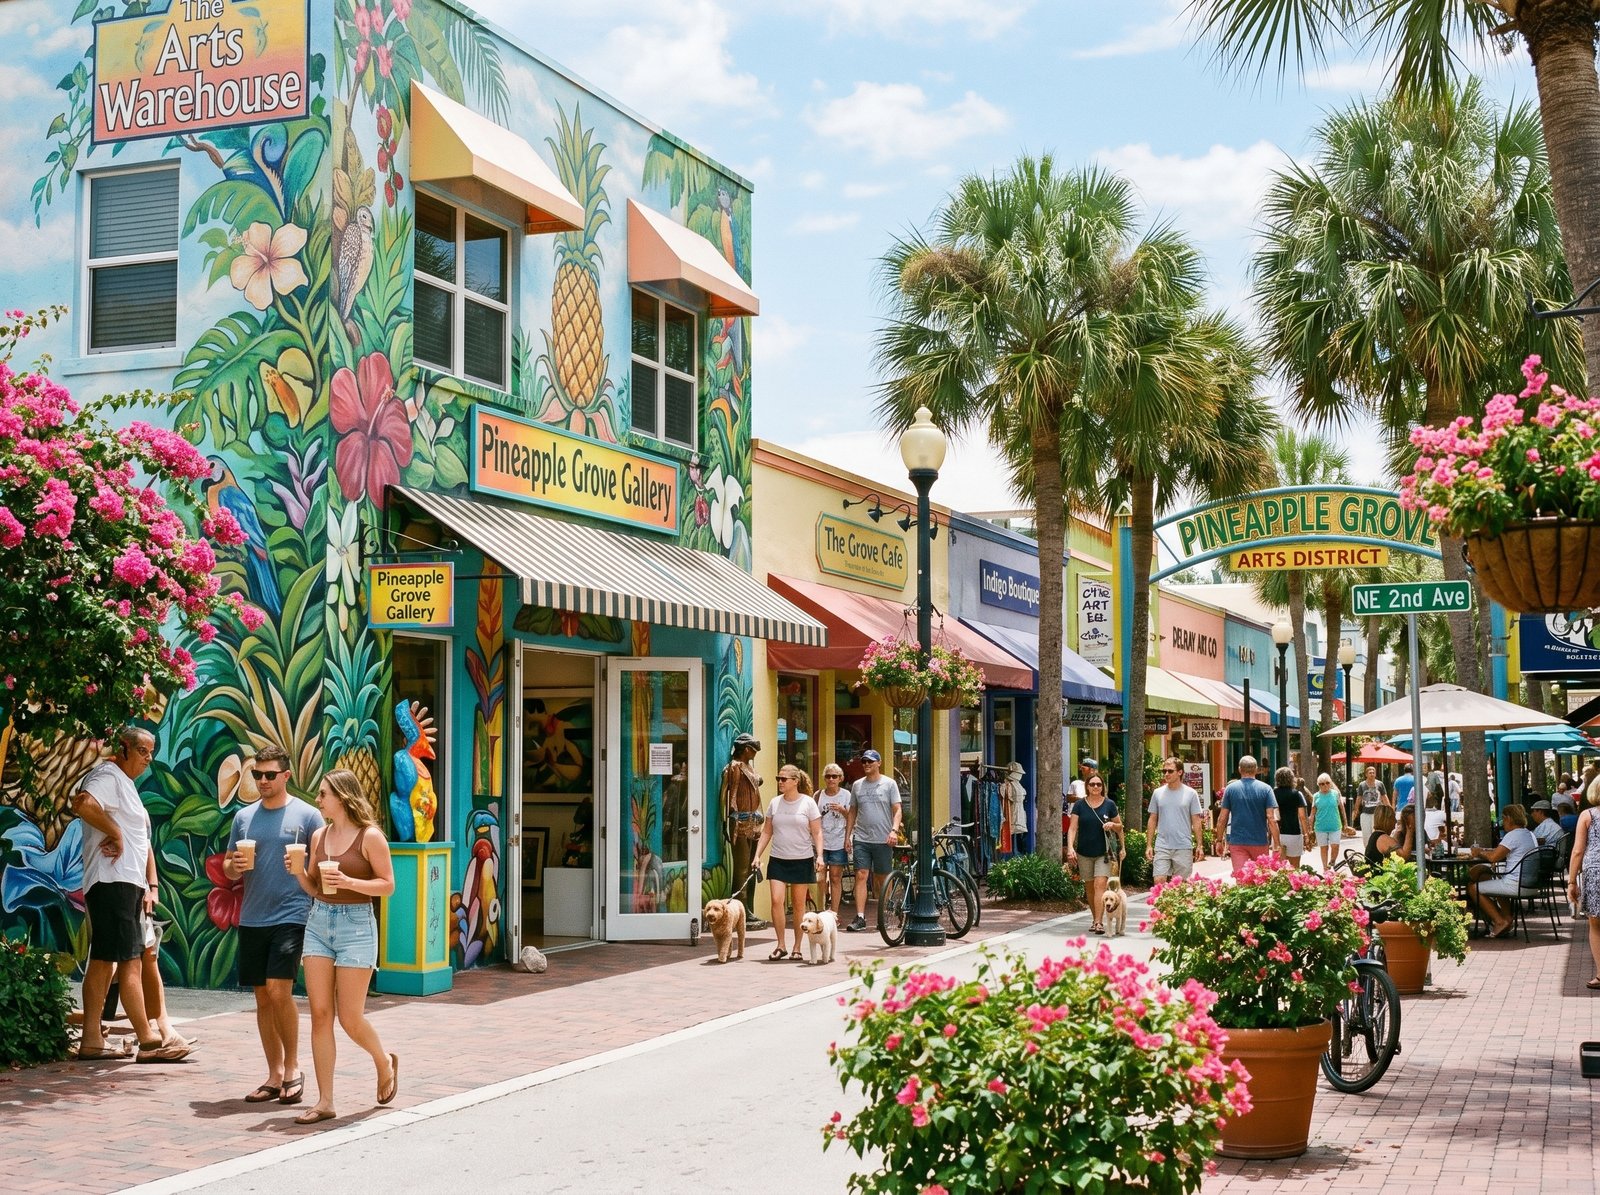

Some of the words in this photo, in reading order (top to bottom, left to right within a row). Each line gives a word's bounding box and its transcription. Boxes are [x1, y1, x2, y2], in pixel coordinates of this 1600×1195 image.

[180, 0, 224, 21] The
[154, 22, 243, 76] Arts
[99, 70, 301, 132] Warehouse
[482, 423, 566, 494] Pineapple
[572, 448, 616, 500] Grove
[621, 462, 672, 522] Gallery
[1177, 494, 1330, 557] PINEAPPLE
[824, 526, 845, 554] The
[848, 533, 878, 563] Grove
[881, 543, 903, 569] Cafe
[1237, 551, 1286, 568] ARTS
[1293, 549, 1381, 566] DISTRICT
[377, 569, 444, 588] Pineapple
[983, 568, 1007, 600] Indigo
[1008, 576, 1039, 609] Boutique
[391, 589, 431, 602] Grove
[1082, 600, 1109, 611] ART
[1356, 590, 1381, 609] NE
[1389, 588, 1422, 608] 2nd
[1432, 587, 1465, 606] Ave
[386, 604, 435, 622] Gallery
[1172, 625, 1196, 653] DELRAY
[1197, 633, 1207, 656] ART
[1208, 636, 1217, 659] CO
